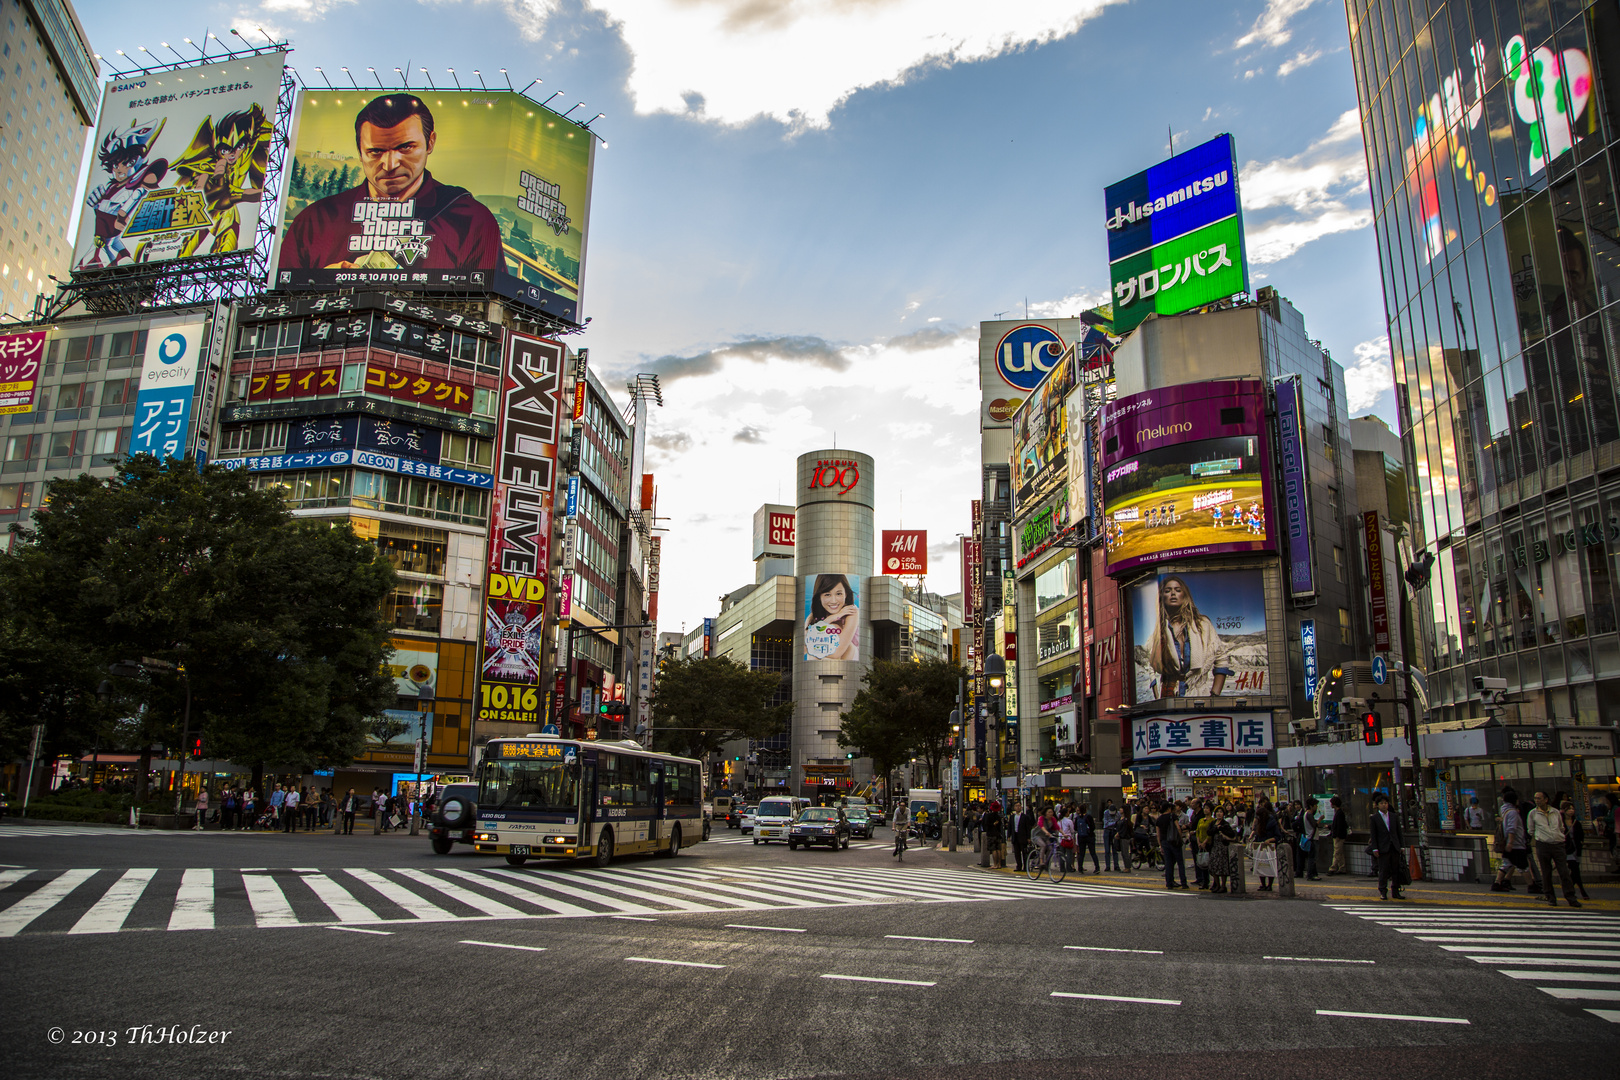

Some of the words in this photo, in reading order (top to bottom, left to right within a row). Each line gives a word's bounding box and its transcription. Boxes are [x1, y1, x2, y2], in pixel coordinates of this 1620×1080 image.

[117, 81, 147, 92] SANYO
[353, 199, 414, 221] grand
[1105, 170, 1228, 229] Hisamitsu
[362, 218, 424, 235] theft
[144, 246, 165, 254] Coming
[412, 273, 428, 282] 発売
[1114, 243, 1232, 306] サロンパス
[311, 319, 366, 340] 月の宴
[383, 323, 445, 352] 月の宴
[1003, 340, 1059, 374] UC
[0, 358, 38, 380] ック
[148, 366, 190, 382] eyecity
[252, 368, 338, 395] プライス
[366, 367, 470, 405] コンタクト
[346, 401, 355, 409] 7F
[366, 401, 376, 410] 7F
[500, 335, 562, 492] EXILE
[1279, 403, 1300, 477] Taisei
[248, 454, 327, 469] 英会話イーオン
[333, 453, 345, 462] 6F
[358, 452, 394, 470] AEON
[401, 460, 491, 486] 英会話イーオン
[808, 465, 860, 495] 109
[1107, 460, 1139, 484] 女子プロ野球
[1285, 479, 1301, 538] neon
[502, 487, 542, 576] LIVE
[772, 516, 795, 529] UNI
[891, 535, 918, 553] H&M
[1139, 554, 1158, 562] WAKASA
[1159, 550, 1182, 559] SEIKATSU
[1183, 547, 1210, 555] CHANNEL
[1366, 514, 1382, 590] クスリのことなら
[489, 573, 545, 600] DVD
[1216, 622, 1242, 630] ¥1,990
[1373, 597, 1389, 645] 三千里
[502, 630, 525, 639] EXILE
[502, 639, 525, 649] PRIDE
[1039, 638, 1070, 660] Euphoria
[1303, 626, 1316, 696] 大盛堂商事ビル
[1235, 670, 1265, 690] H&M
[481, 684, 538, 711] 10.16
[479, 709, 498, 720] ON
[500, 710, 537, 722] SALE!!
[1136, 719, 1264, 751] 大盛堂書店
[1512, 739, 1537, 749] 渋谷駅
[1564, 740, 1593, 750] しぶちか
[516, 747, 561, 757] 渋谷駅
[618, 808, 627, 816] BUS
